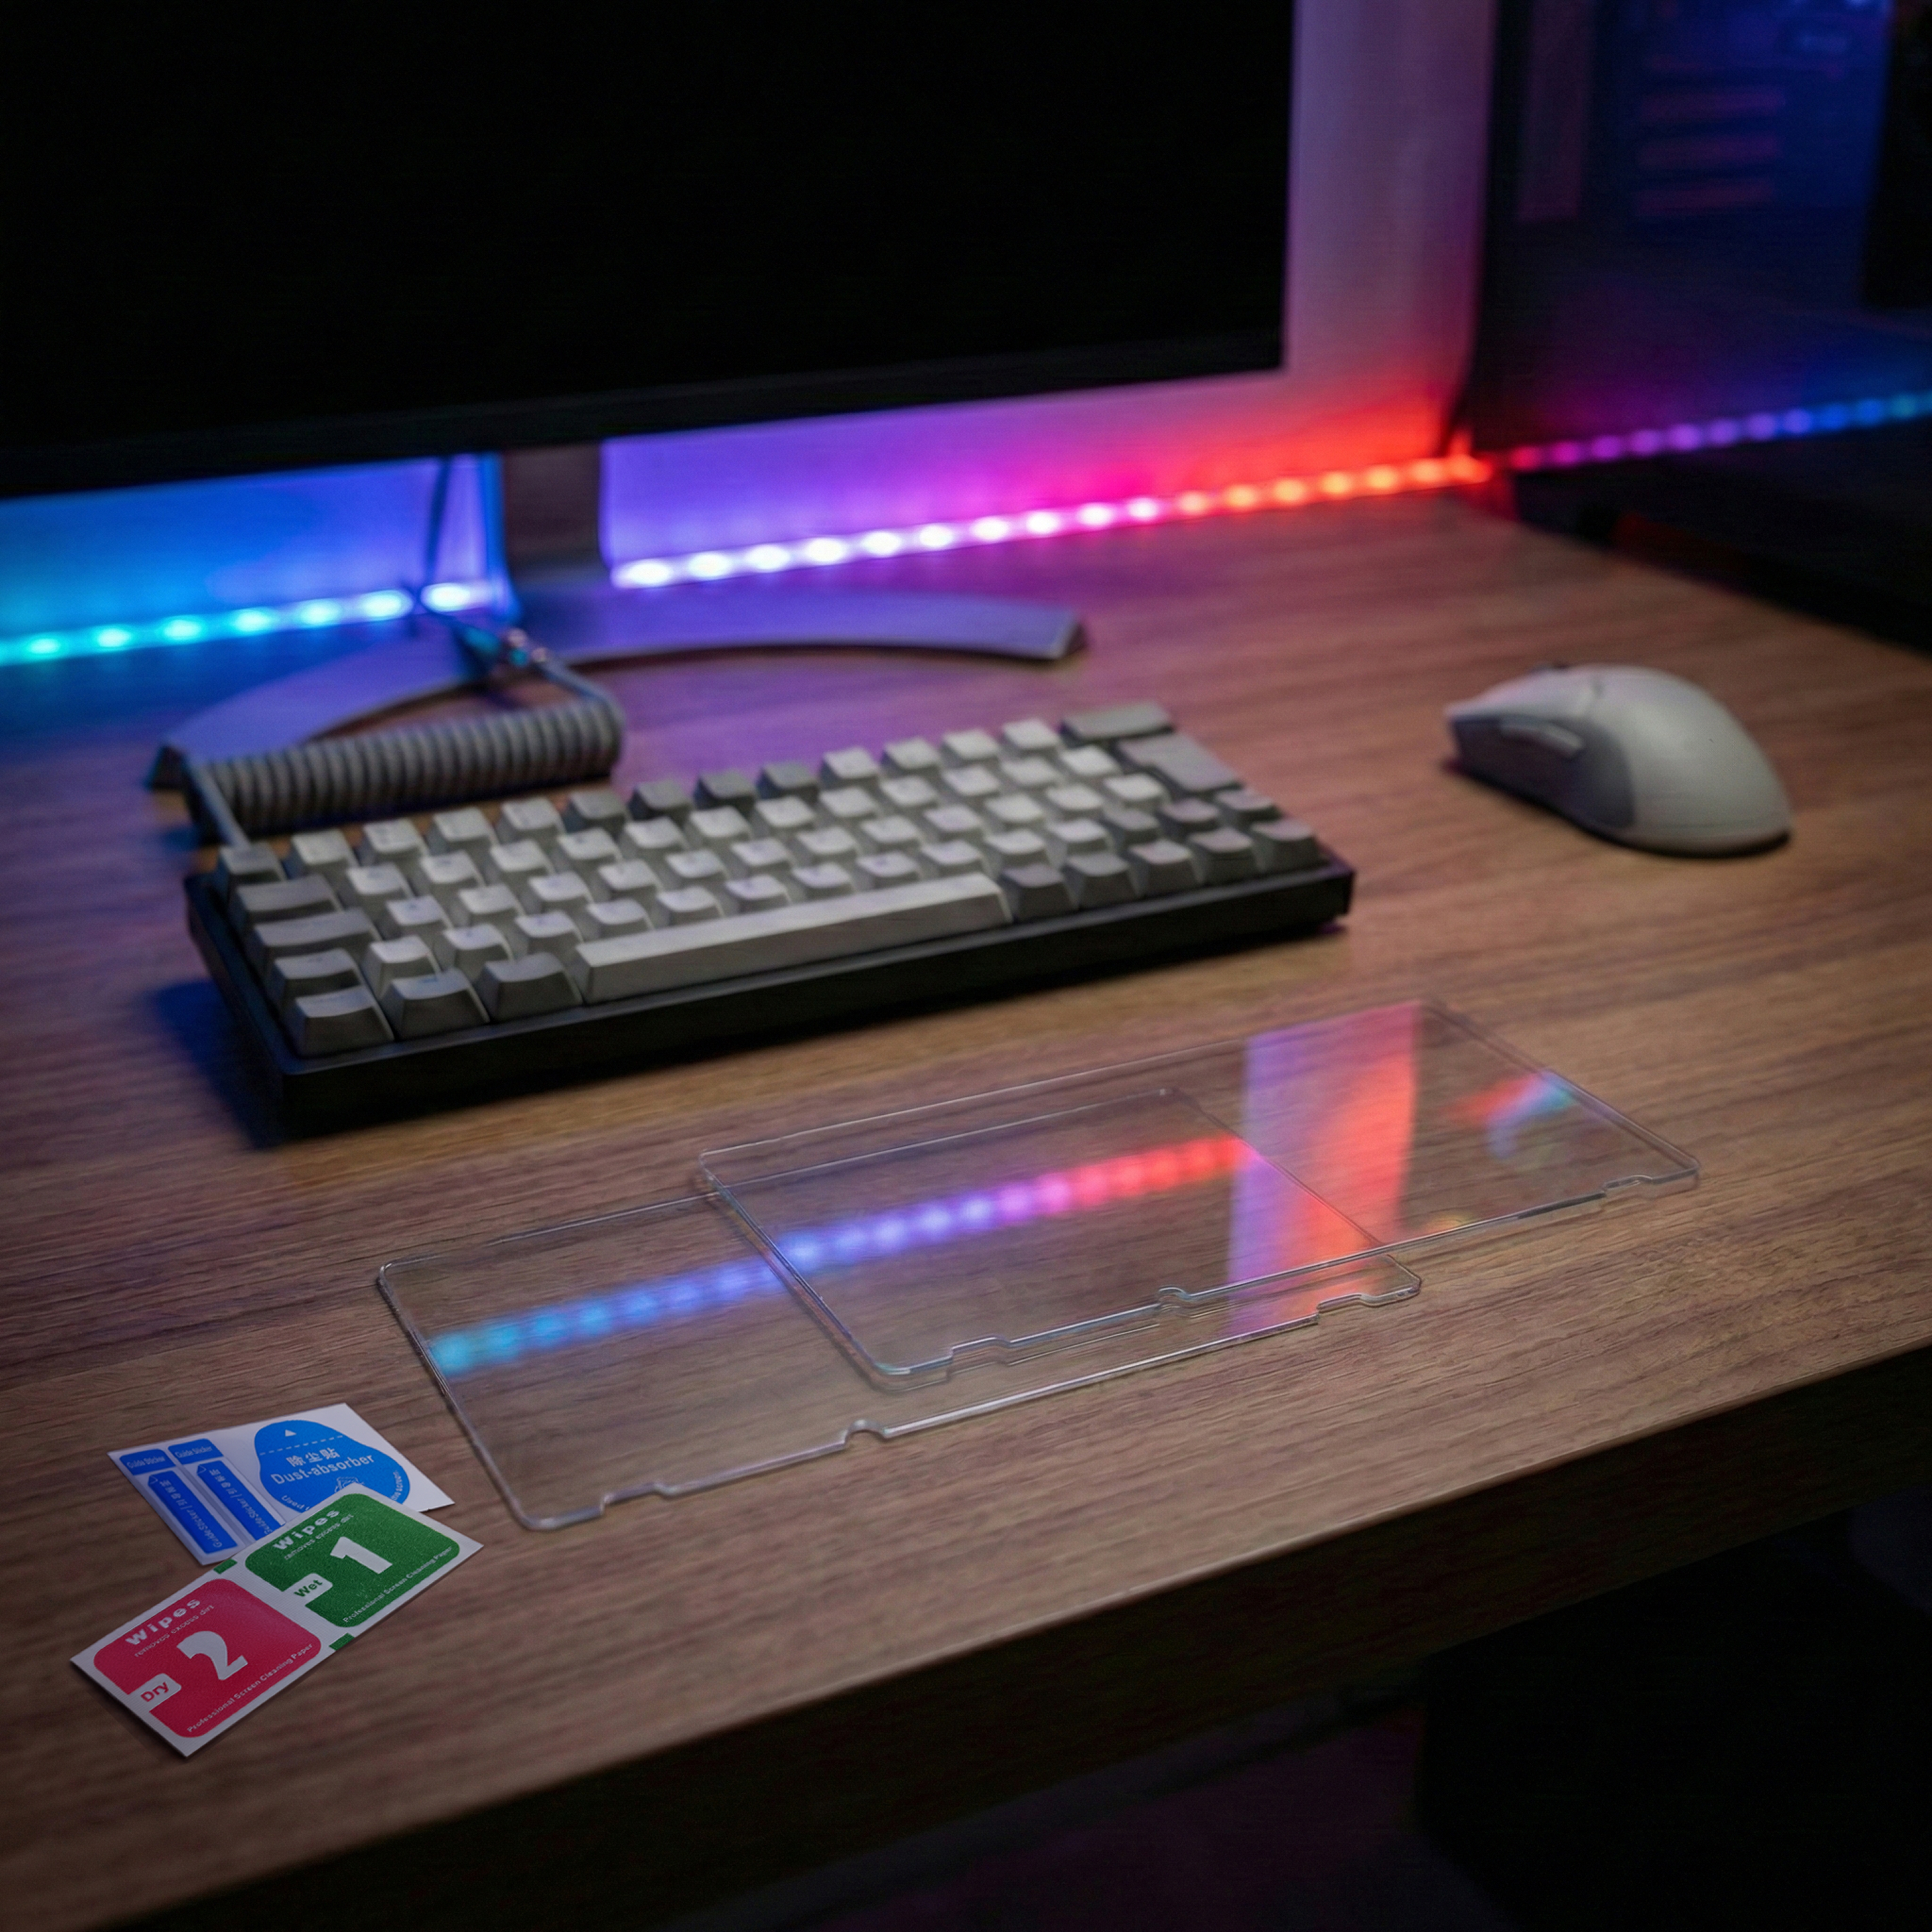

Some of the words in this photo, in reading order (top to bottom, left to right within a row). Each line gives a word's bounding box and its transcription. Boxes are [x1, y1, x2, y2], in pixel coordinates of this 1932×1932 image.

[270, 1454, 375, 1484] Dust-absorber
[285, 1447, 341, 1468] 除尘贴
[281, 1495, 306, 1510] Used
[273, 1511, 339, 1549] Wipes
[330, 1536, 393, 1574] 1
[294, 1580, 322, 1597] Wet
[343, 1593, 385, 1623] Professional
[384, 1578, 408, 1595] Screen
[406, 1558, 436, 1578] Cleaning
[433, 1546, 451, 1560] Paper
[125, 1599, 200, 1645] Wipes
[135, 1633, 169, 1657] removes
[171, 1615, 199, 1634] excess
[200, 1605, 214, 1615] dirt
[176, 1631, 249, 1681] 2
[140, 1682, 168, 1701] Dry
[187, 1698, 235, 1732] Professional
[234, 1680, 261, 1700] Screen
[260, 1658, 293, 1681] Cleaning
[291, 1643, 312, 1660] Paper
